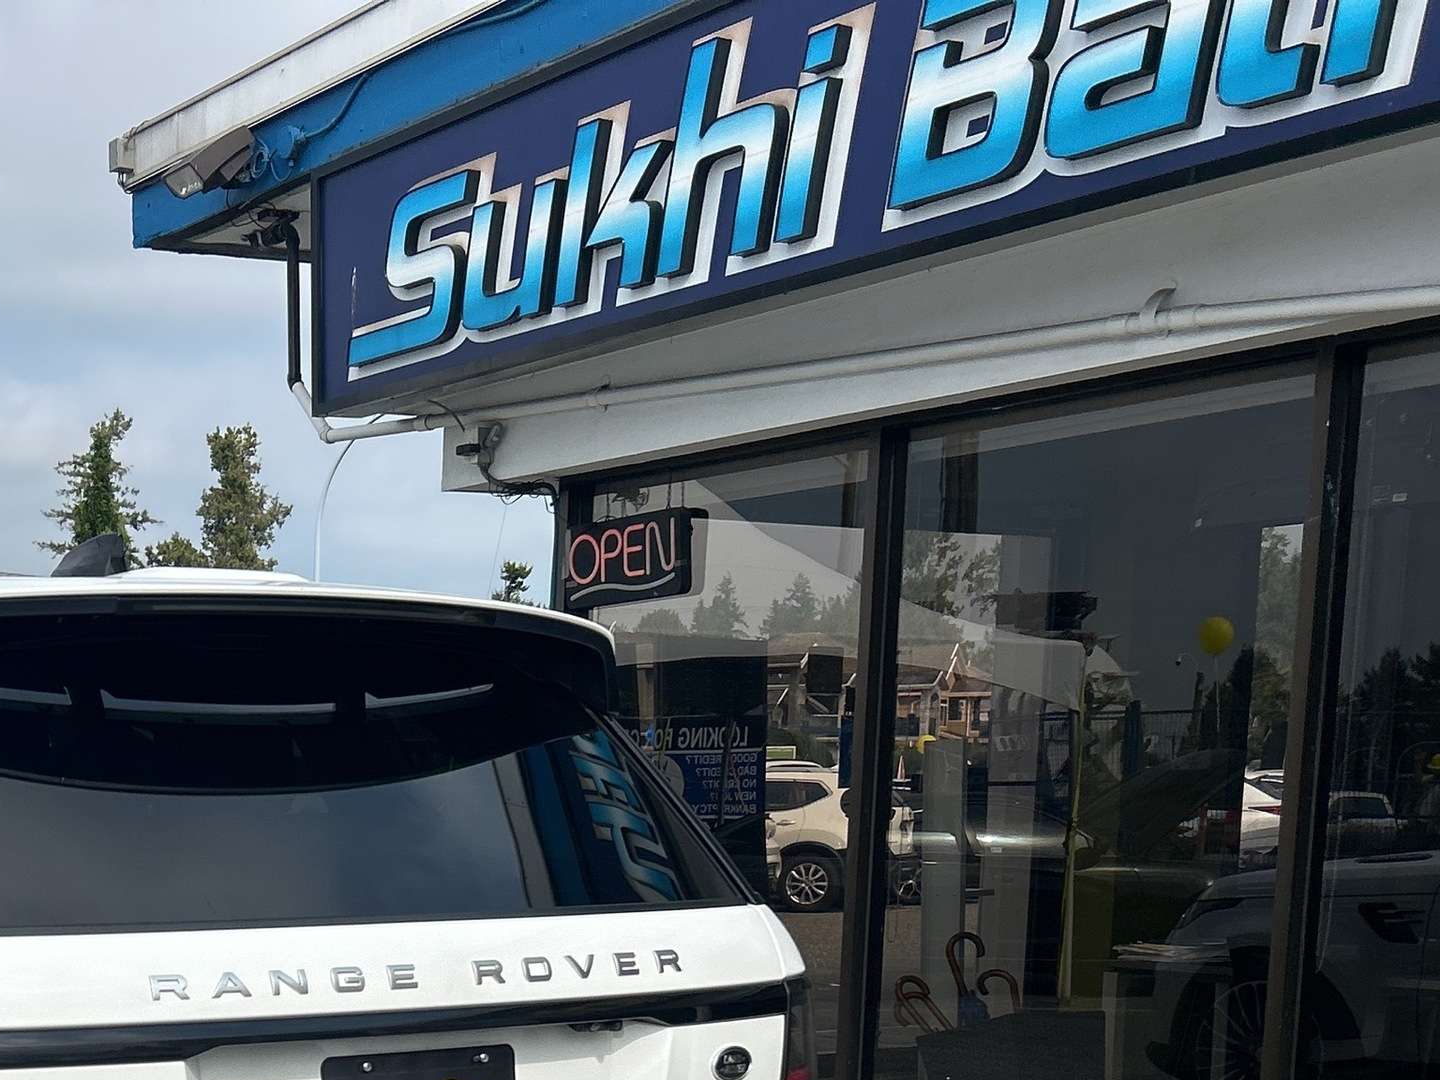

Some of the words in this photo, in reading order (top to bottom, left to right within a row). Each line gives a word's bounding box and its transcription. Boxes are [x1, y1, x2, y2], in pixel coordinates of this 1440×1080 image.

[348, 16, 858, 371] Sukhi
[884, 0, 1432, 214] Ba
[569, 517, 675, 585] OPEN
[149, 964, 418, 1001] RANGE
[472, 949, 682, 985] ROVER
